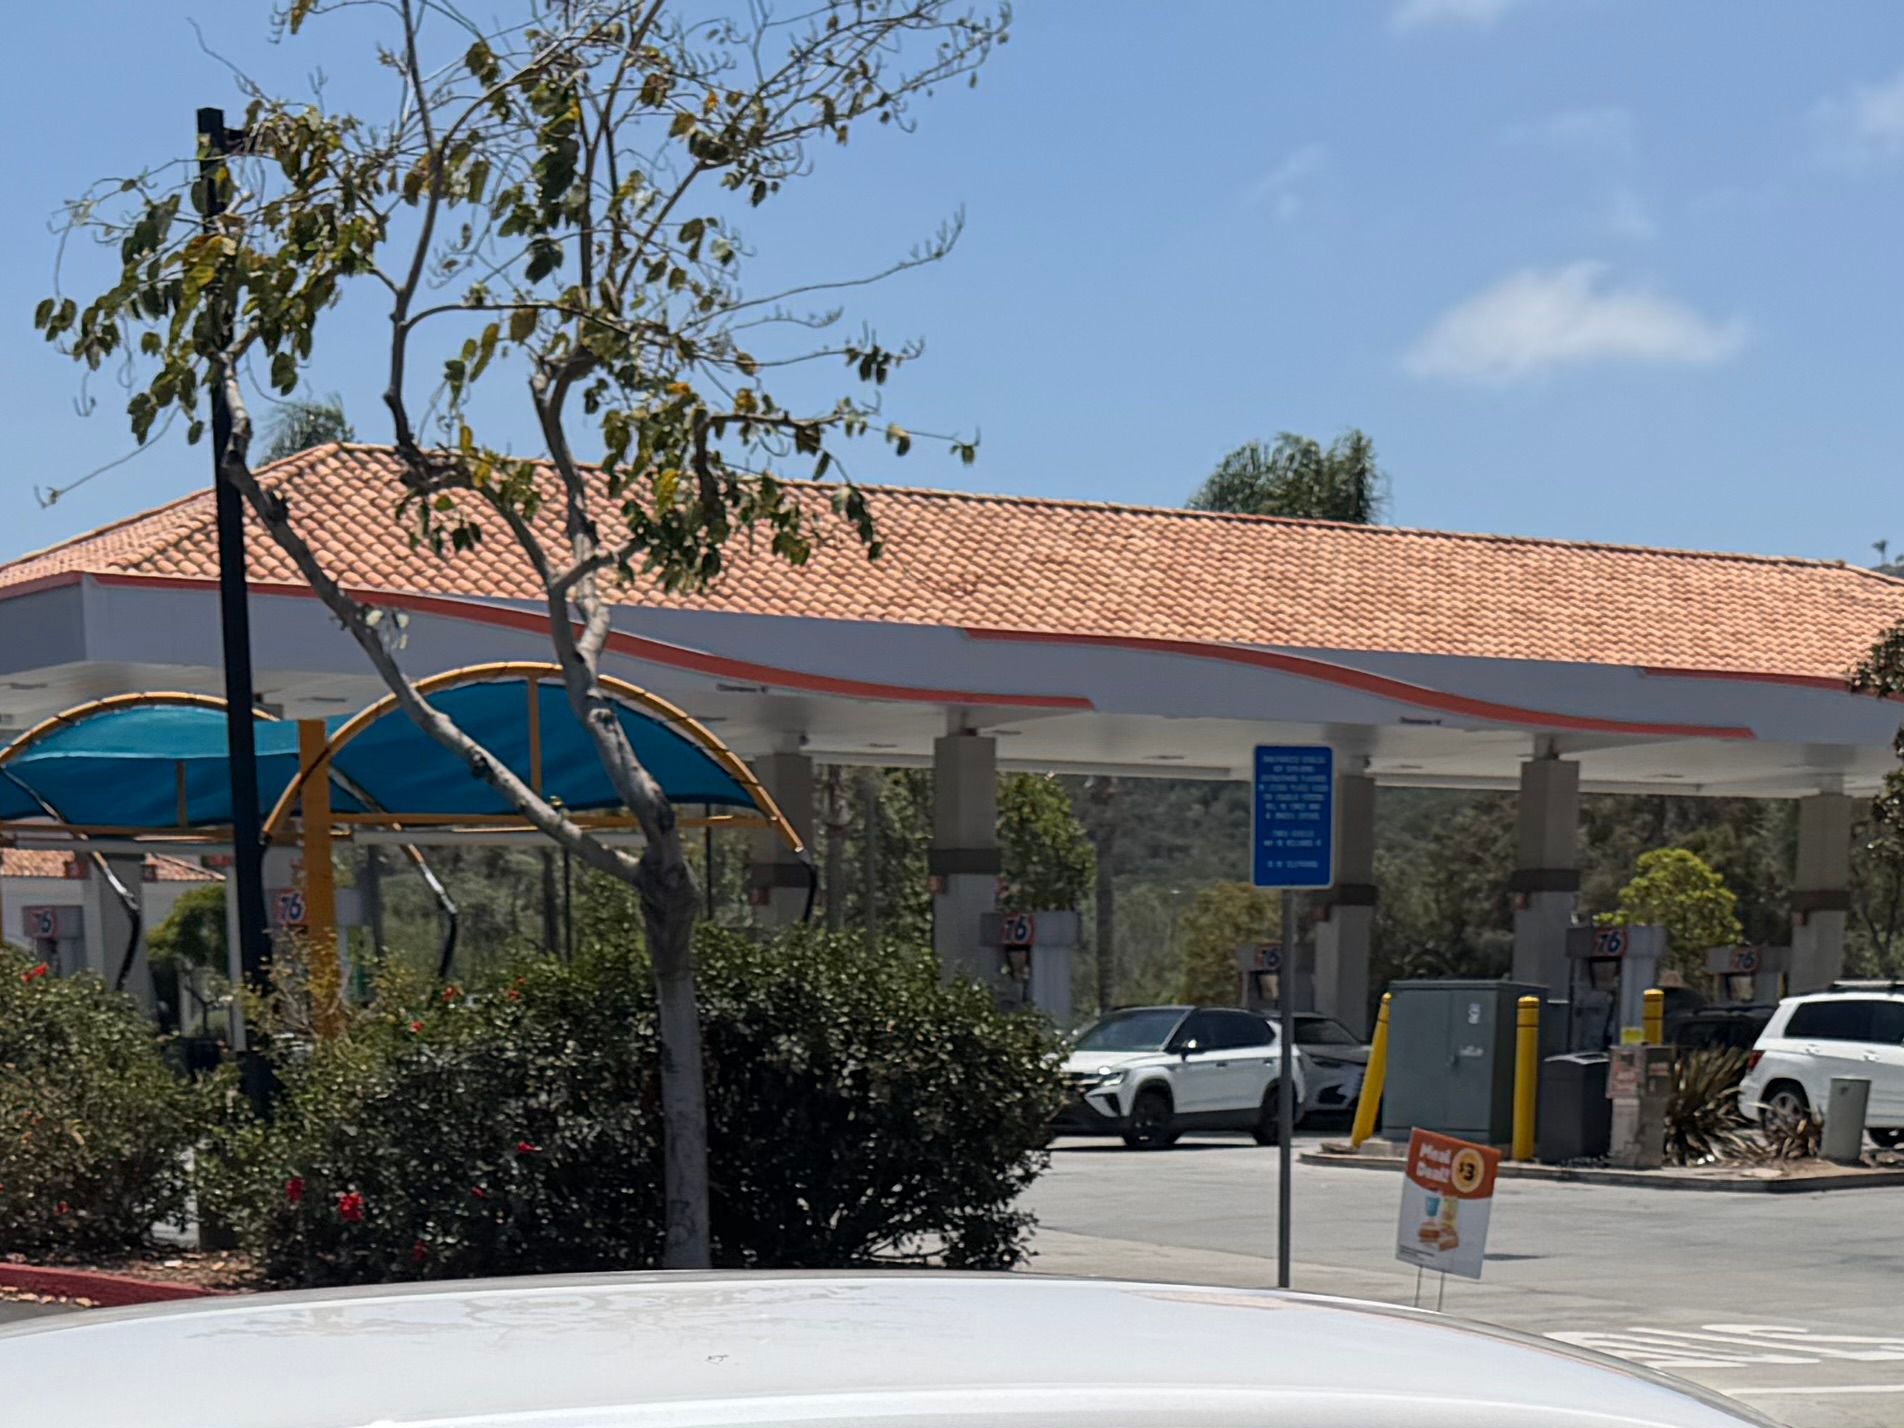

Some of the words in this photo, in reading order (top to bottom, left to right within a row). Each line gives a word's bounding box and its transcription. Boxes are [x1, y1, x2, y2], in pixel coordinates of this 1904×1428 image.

[280, 893, 303, 921] 76
[1004, 916, 1027, 941] 76
[1599, 930, 1621, 952] 76
[1736, 950, 1755, 970] 76
[1419, 1143, 1452, 1166] Meal
[1459, 1160, 1476, 1182] $3
